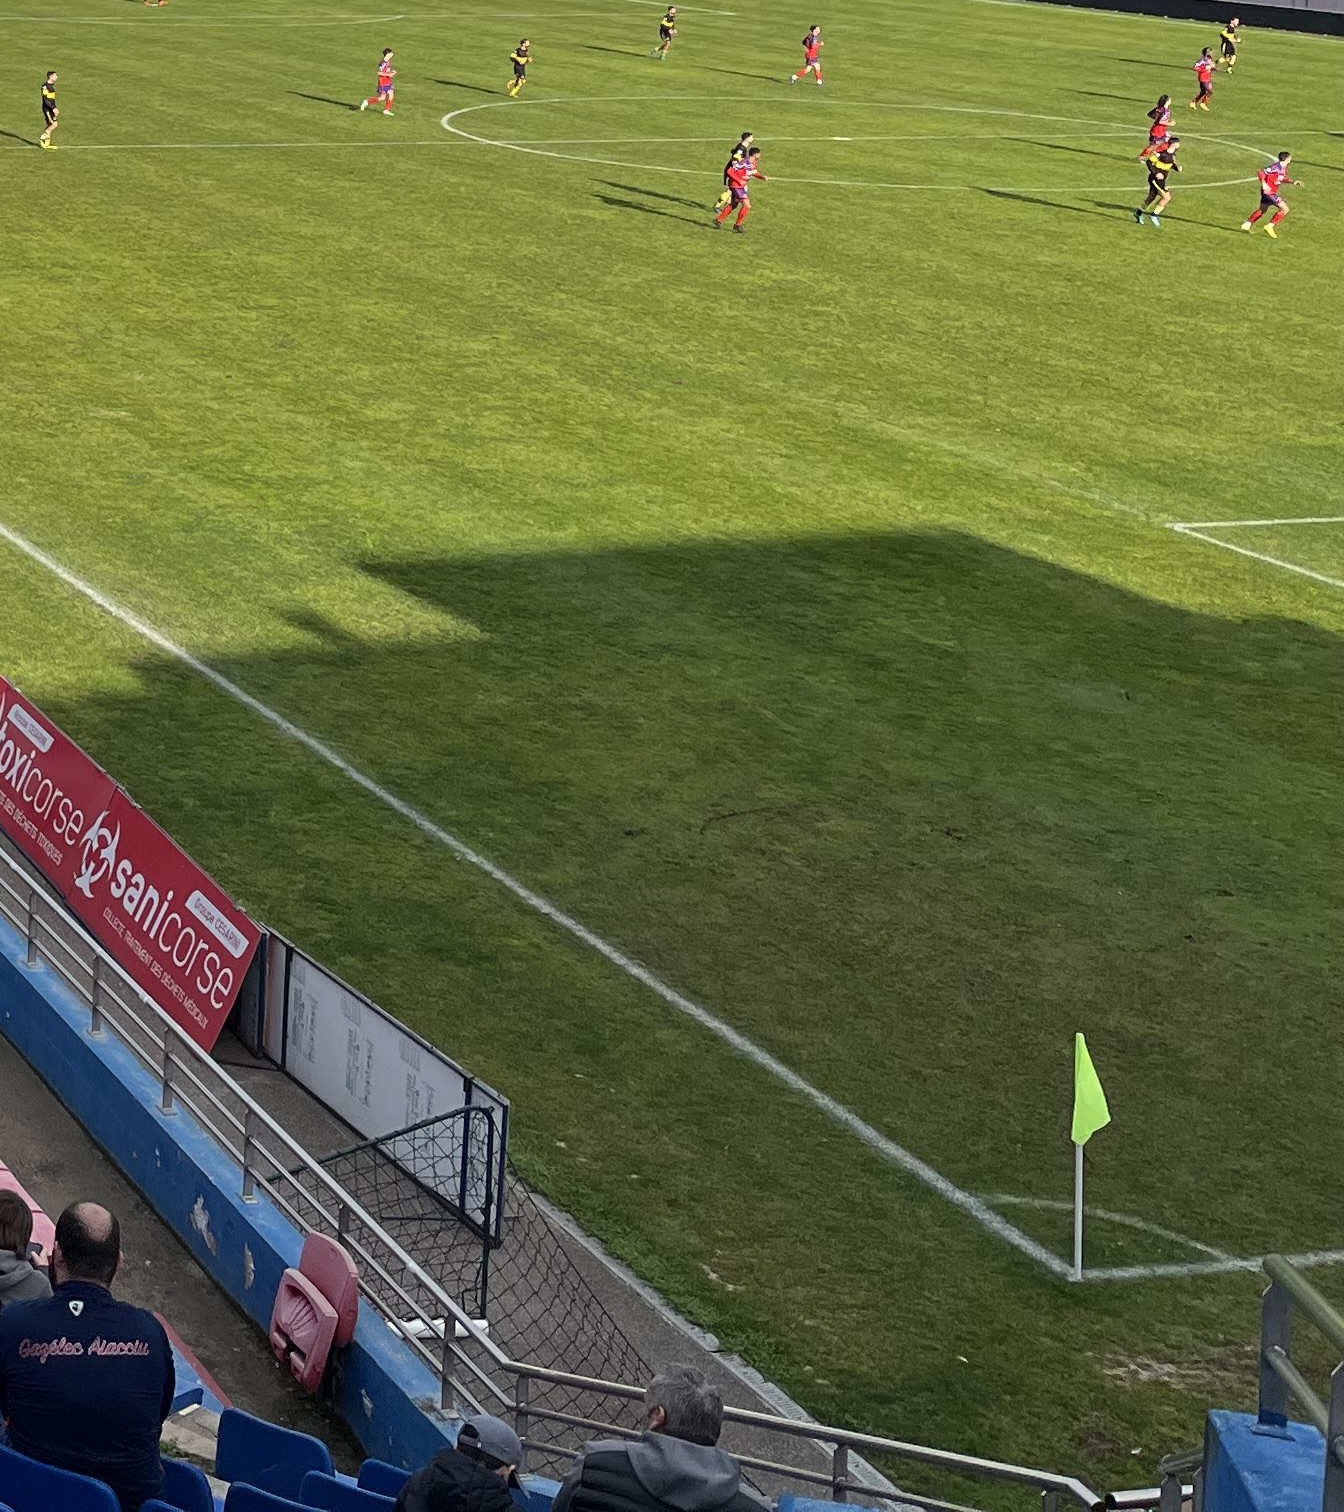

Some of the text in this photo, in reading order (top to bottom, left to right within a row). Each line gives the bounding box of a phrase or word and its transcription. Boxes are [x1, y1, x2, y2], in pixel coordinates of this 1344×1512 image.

[3, 799, 15, 816] DES
[36, 832, 63, 866] TOXIQUES
[110, 859, 233, 1009] sanicorse
[124, 930, 154, 967] TRAITEMENT
[150, 959, 164, 979] DES
[18, 1336, 84, 1364] Gazélec
